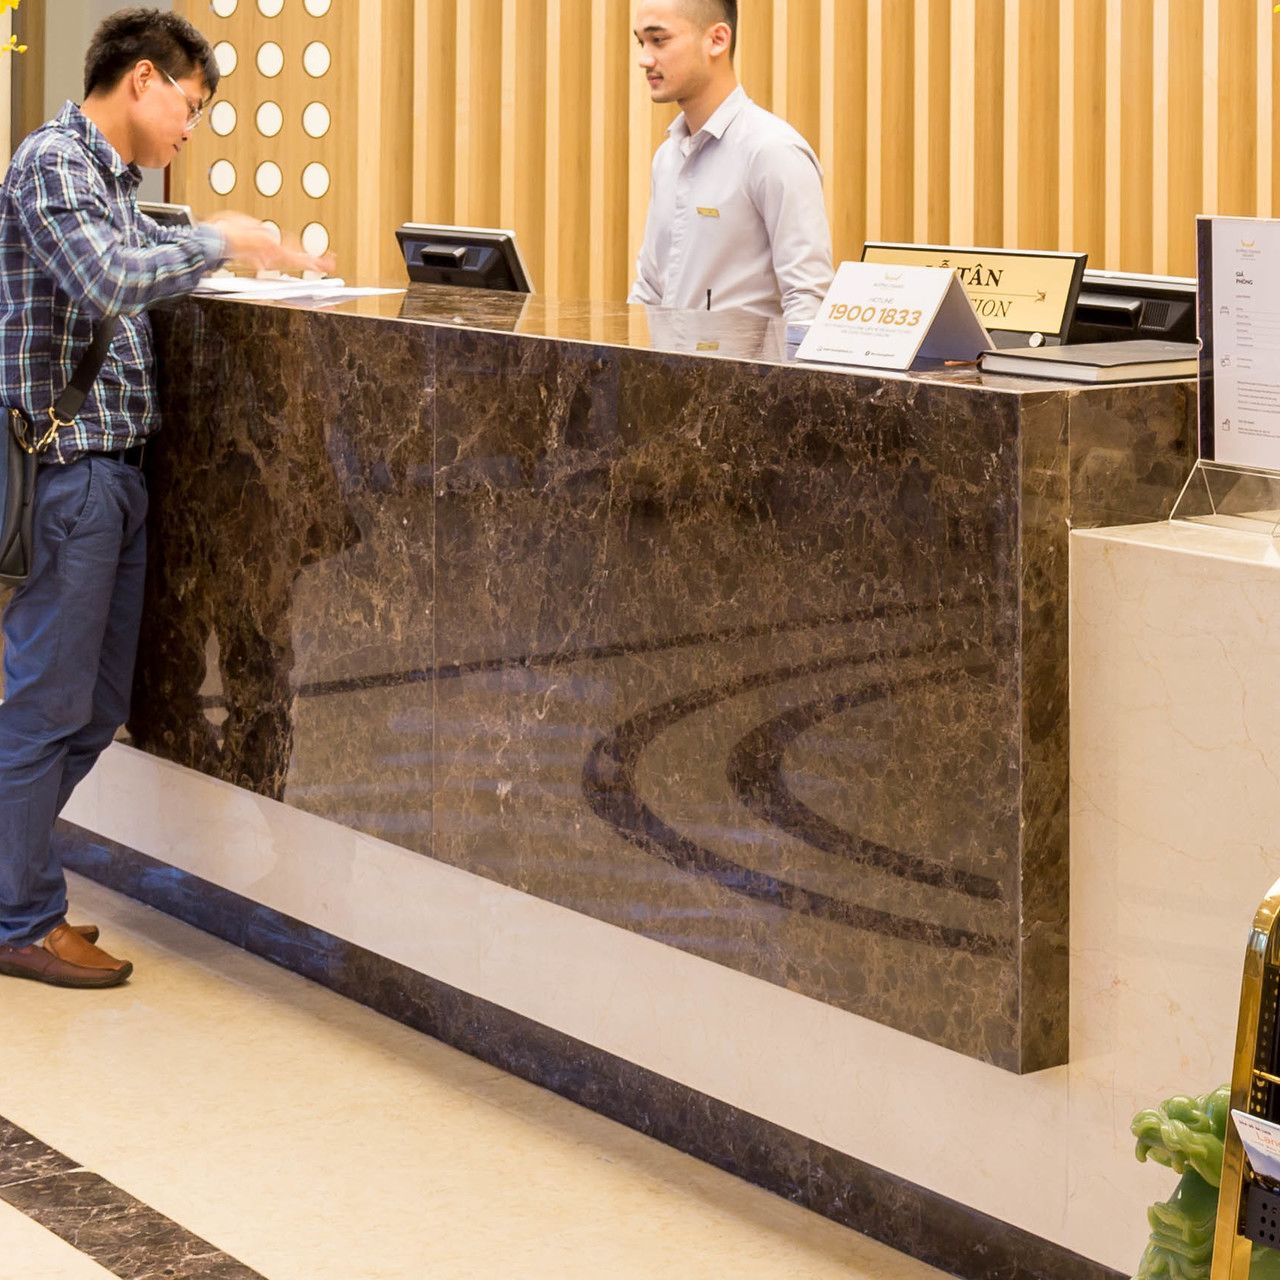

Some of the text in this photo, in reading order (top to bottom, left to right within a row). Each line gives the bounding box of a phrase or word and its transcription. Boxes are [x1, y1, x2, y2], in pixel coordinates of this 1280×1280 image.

[957, 264, 1004, 287] TÂN
[828, 303, 923, 327] 1900 1833
